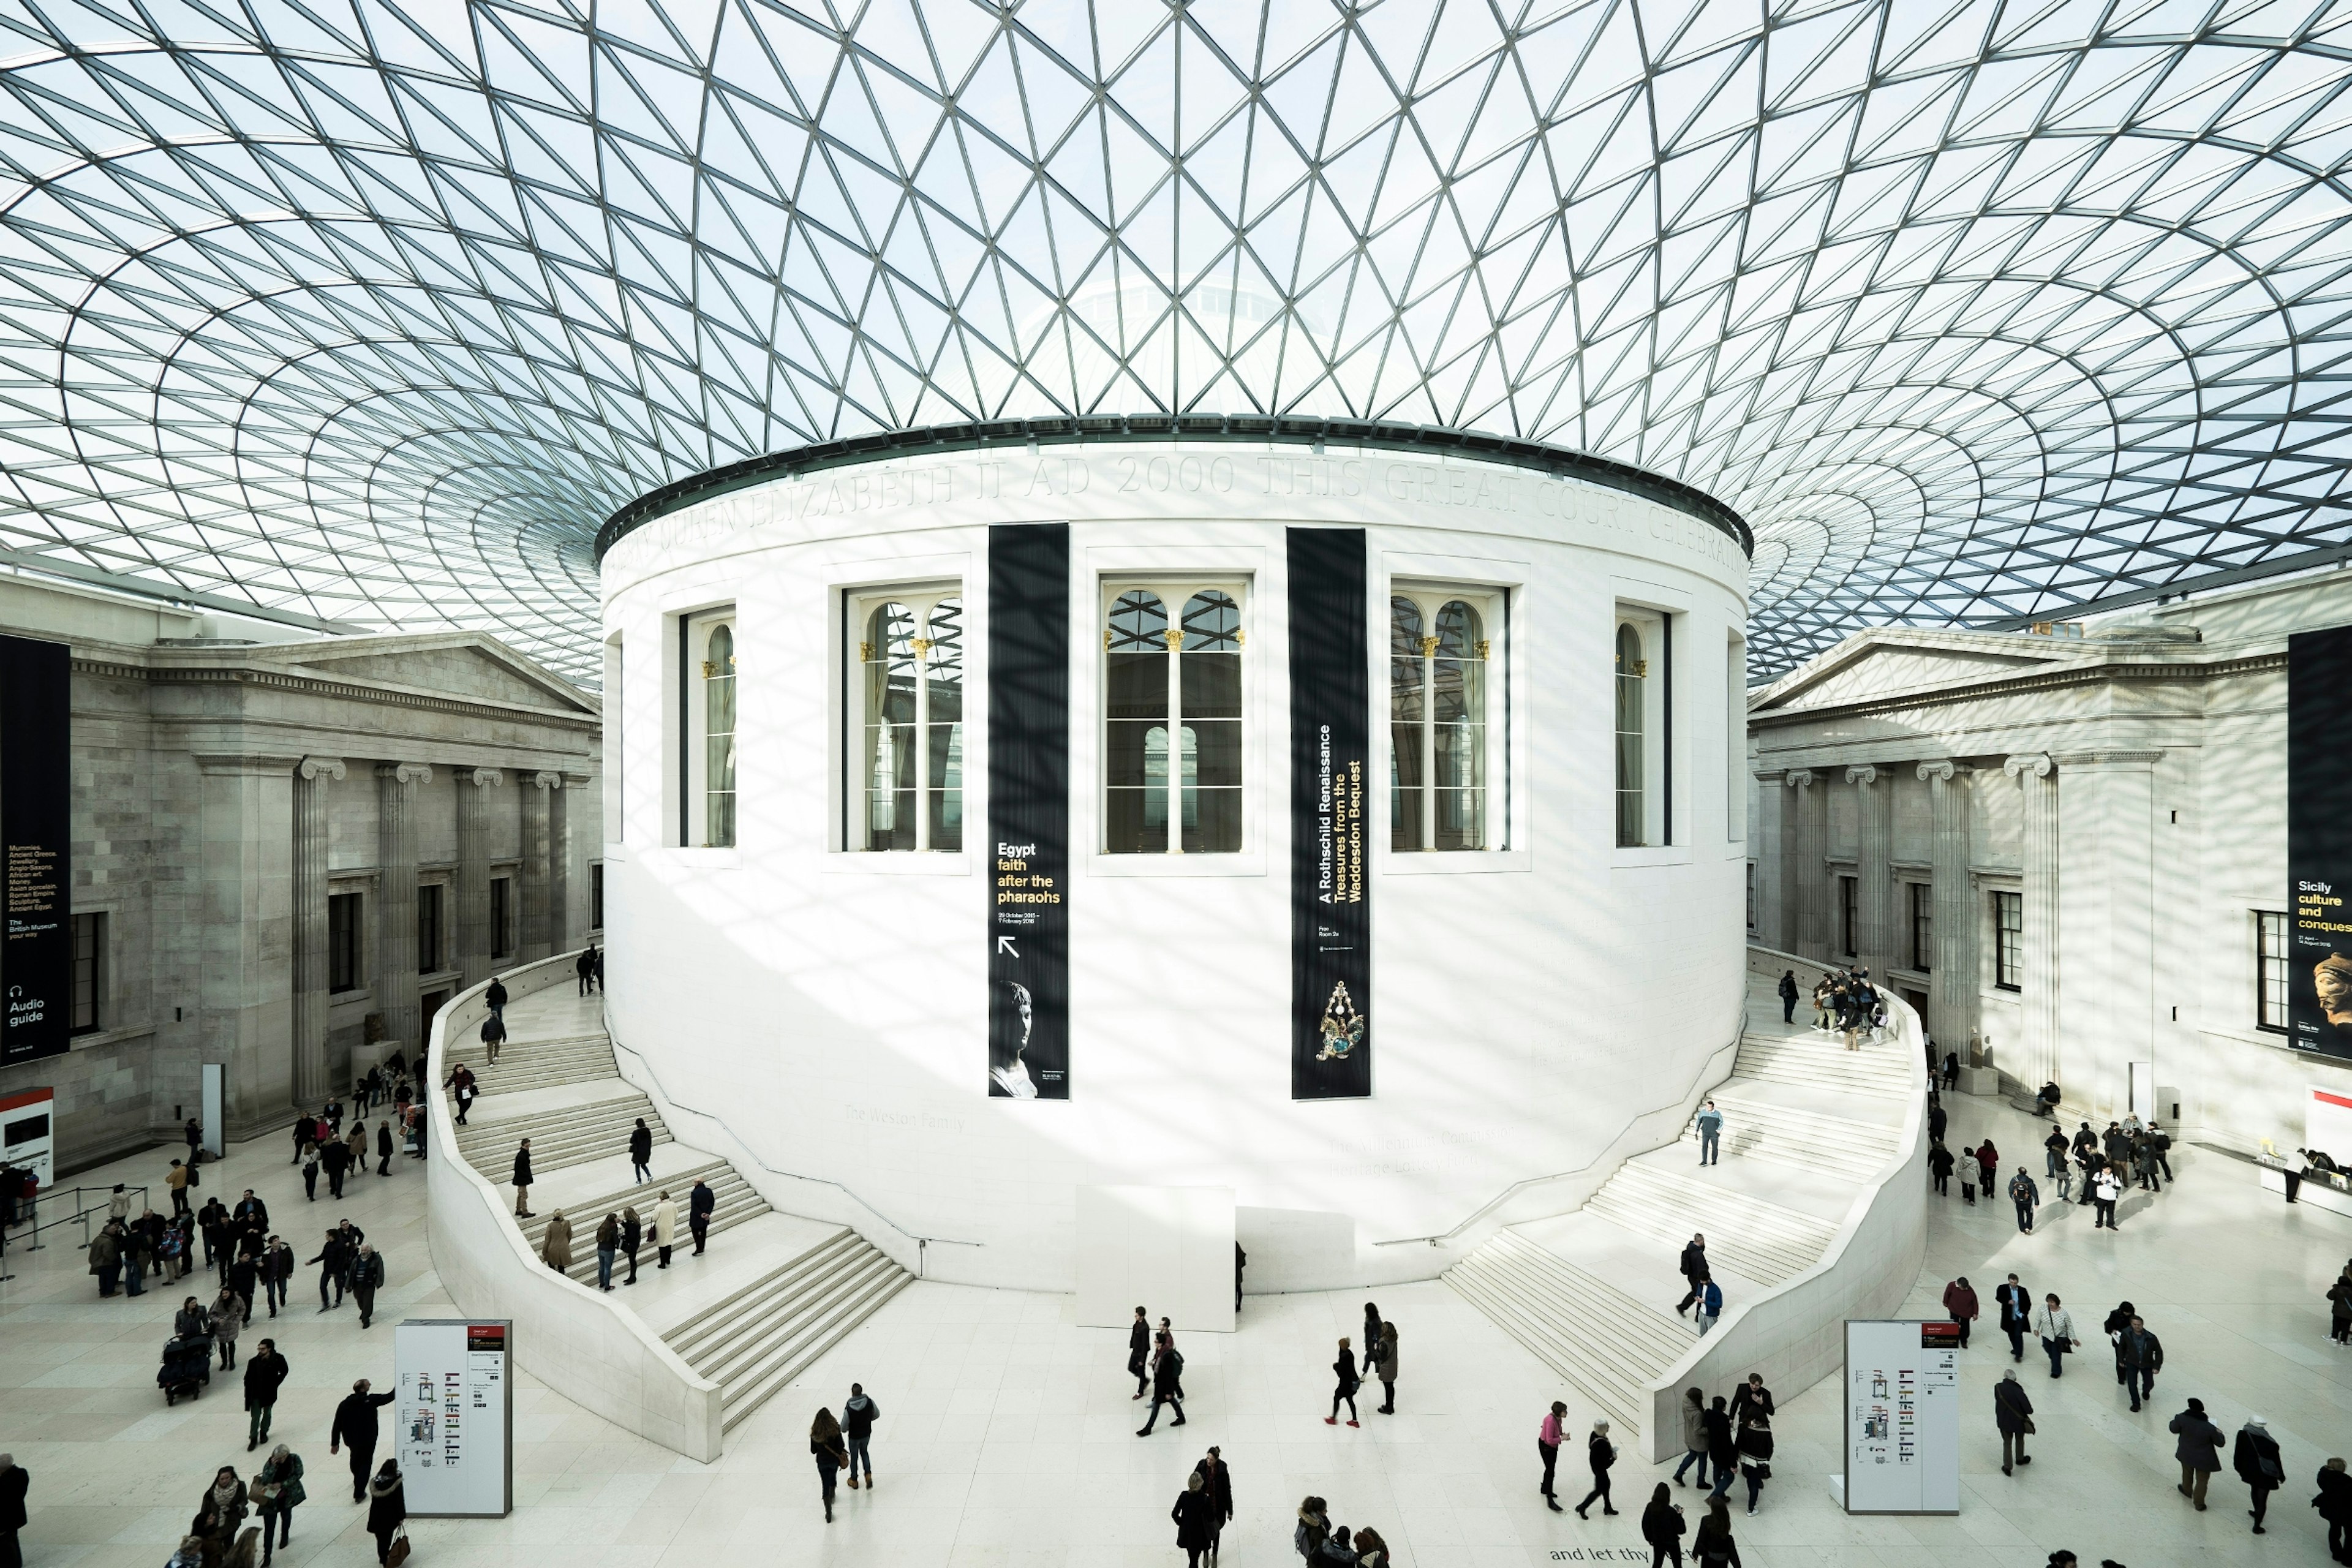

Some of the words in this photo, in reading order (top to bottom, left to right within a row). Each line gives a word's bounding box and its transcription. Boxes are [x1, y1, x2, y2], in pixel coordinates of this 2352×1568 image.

[660, 499, 738, 553] QUEEN
[748, 466, 959, 528] ELIZABETH
[976, 461, 1006, 499] II
[1024, 458, 1090, 497] AD
[1117, 455, 1234, 492] 2000
[1257, 457, 1363, 497] THIS
[1385, 464, 1520, 513] GREAT
[1536, 481, 1637, 534] COURT
[1319, 725, 1330, 813] Renaissance
[1333, 773, 1345, 797] the
[1349, 761, 1362, 818] Bequest
[1334, 800, 1346, 833] from
[998, 842, 1036, 858] Egypt
[1319, 817, 1331, 889] Rothschild
[998, 859, 1027, 871] faith
[1334, 836, 1346, 903] Treasures
[1349, 822, 1361, 903] Waddesdon
[998, 875, 1028, 887] after
[1031, 875, 1054, 887] the
[2299, 881, 2332, 894] Sicily
[998, 891, 1060, 905] pharaohs
[1319, 894, 1331, 903] A
[2299, 894, 2342, 907] culture
[2299, 907, 2321, 917] and
[2299, 920, 2352, 932] conques
[9, 999, 44, 1013] Audio
[10, 1011, 43, 1027] guide
[844, 1104, 865, 1121] The
[870, 1107, 917, 1126] Weston
[922, 1112, 966, 1133] Family
[1329, 1137, 1354, 1155] The
[1359, 1134, 1437, 1152] Millennium
[1442, 1126, 1516, 1145] Commission
[1329, 1161, 1390, 1178] Heritage
[1550, 1548, 1585, 1561] and
[1588, 1548, 1616, 1561] let
[1619, 1548, 1649, 1564] thy
